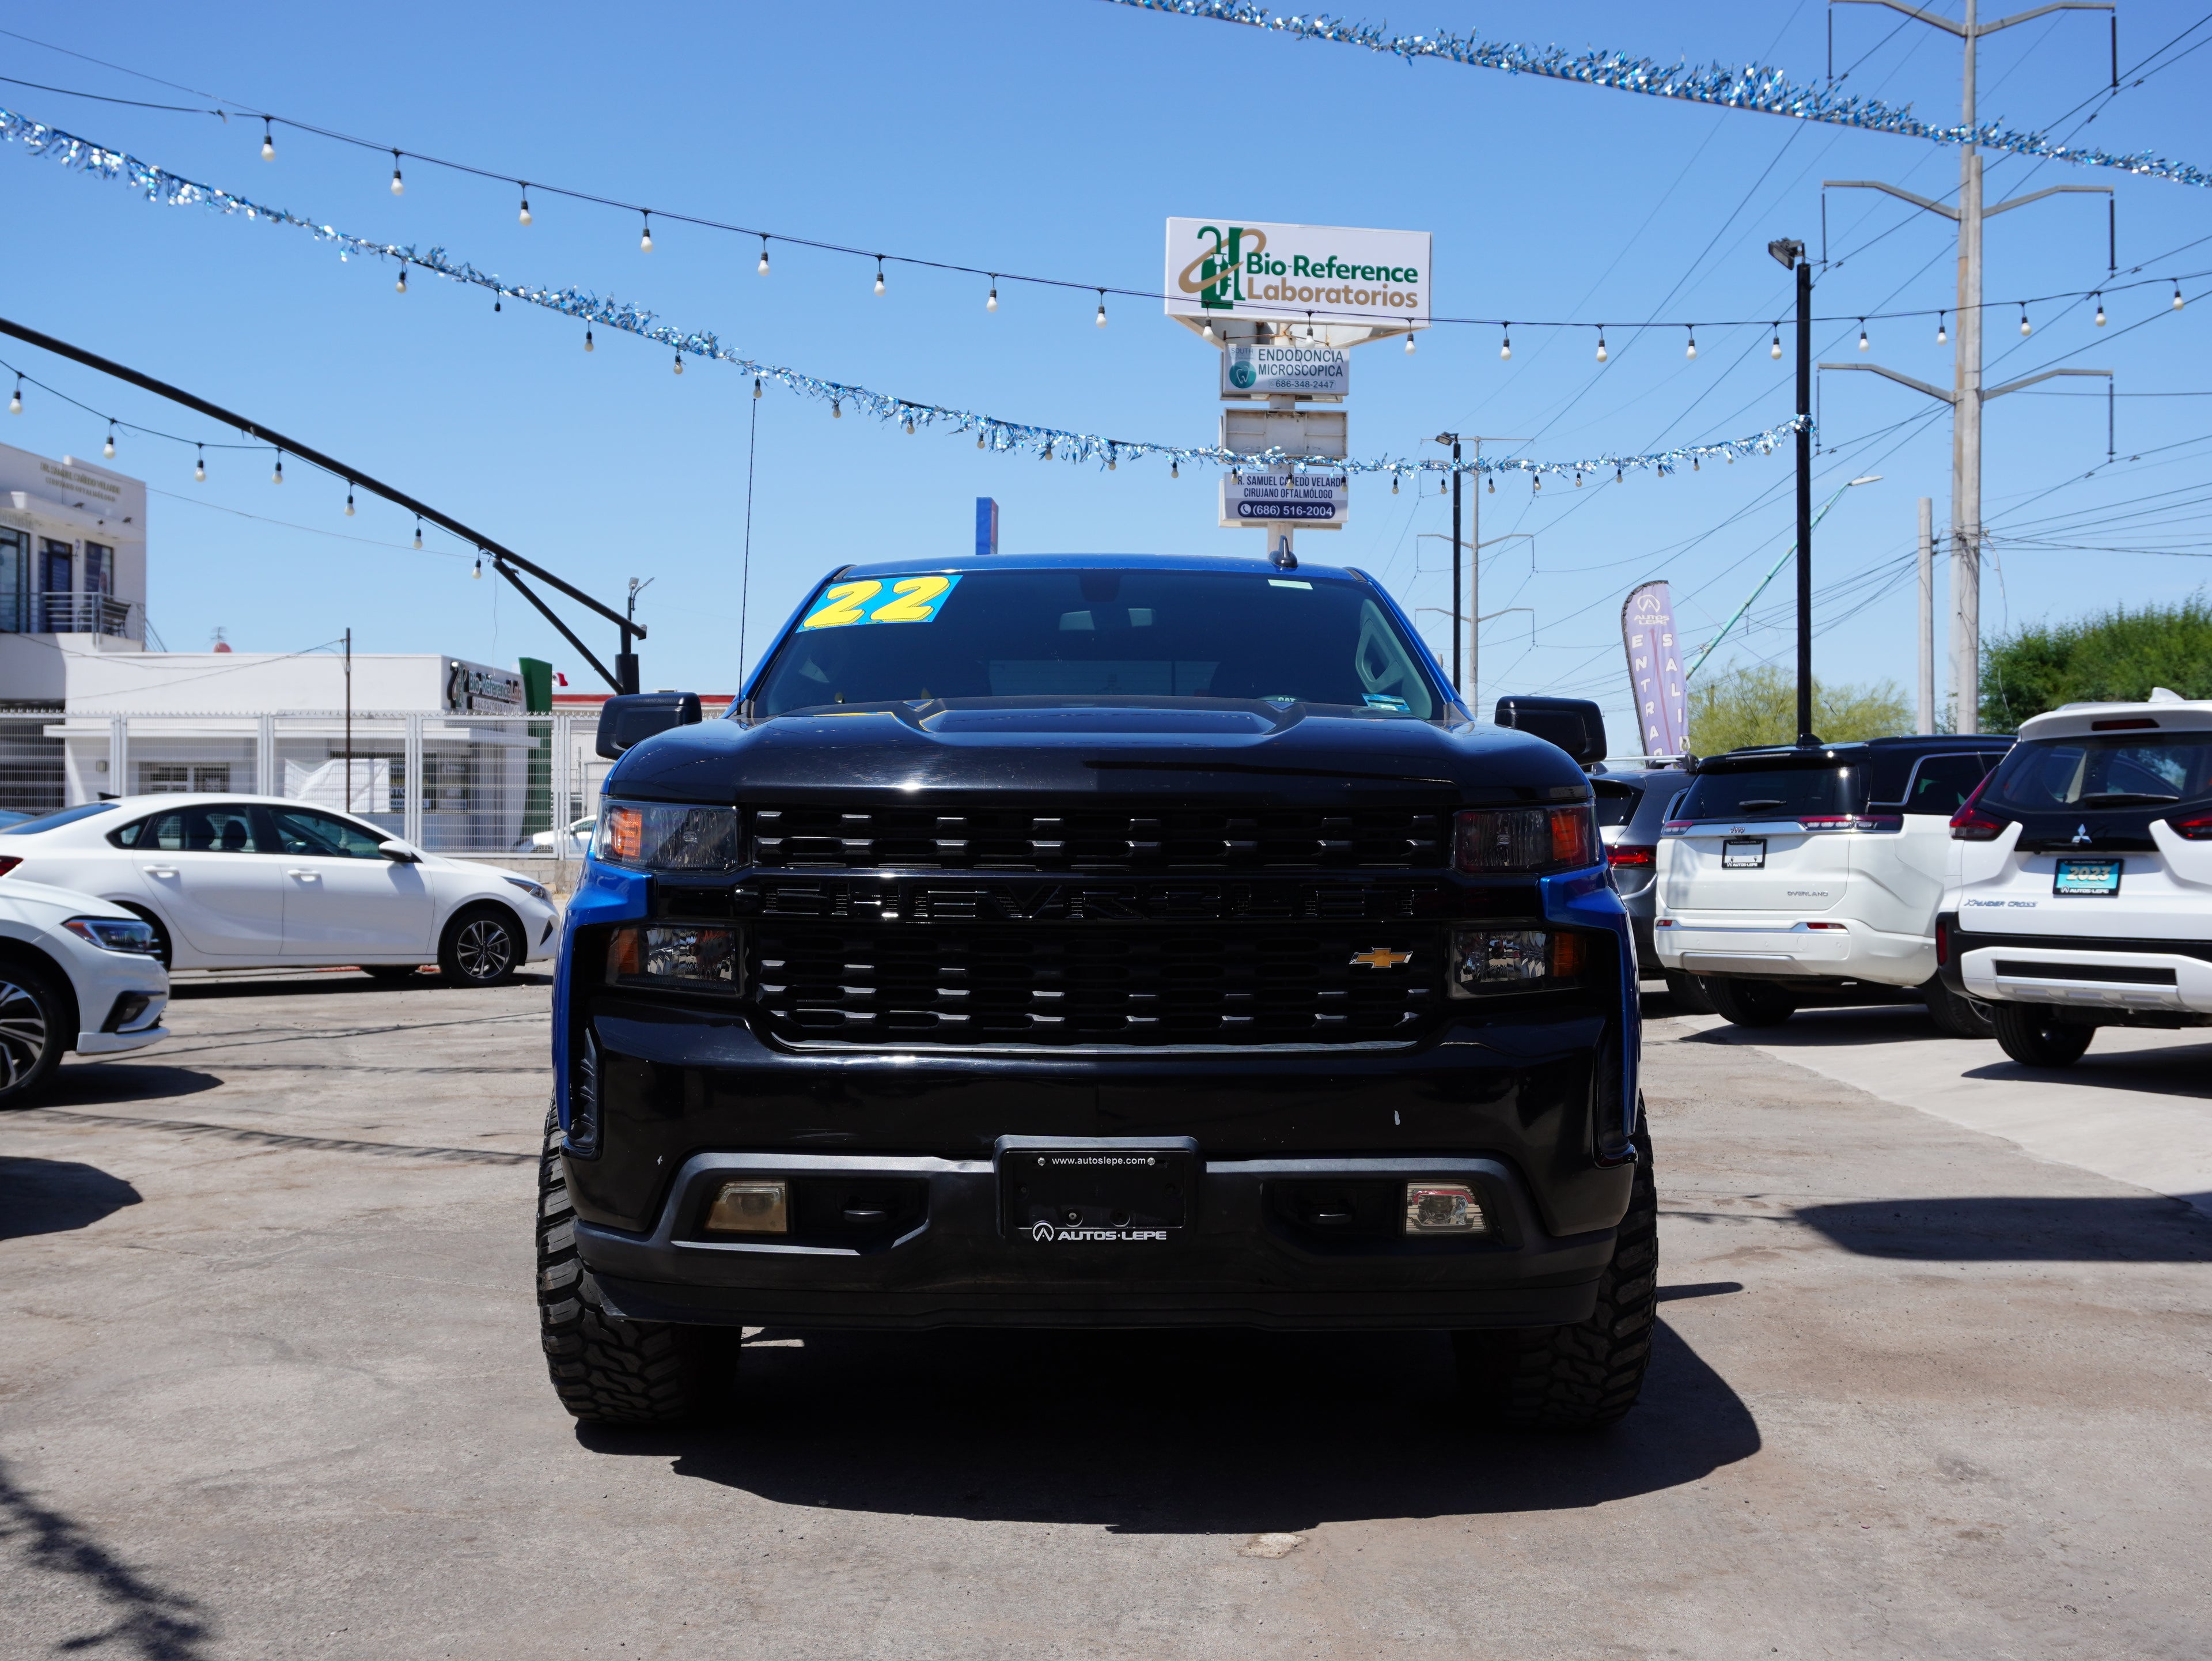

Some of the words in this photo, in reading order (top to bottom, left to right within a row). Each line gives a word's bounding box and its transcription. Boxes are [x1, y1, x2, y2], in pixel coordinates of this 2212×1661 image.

[1247, 251, 1418, 283] Bio-Reference
[1247, 277, 1418, 308] Laboratorios
[1259, 349, 1343, 362] ENDODONCIA
[1259, 364, 1343, 377] MICROSCOPICA
[1275, 380, 1334, 388] 686-348-2447
[1247, 476, 1277, 486] SAMUEL
[1312, 477, 1343, 487] VELARD
[1244, 488, 1278, 498] CIRUJANO
[1281, 487, 1332, 499] OFTALMÓLOGO
[1253, 505, 1280, 516] (686)
[1283, 505, 1333, 516] 516-2004
[803, 576, 951, 629] 22
[1729, 826, 1745, 834] Jeep
[2066, 867, 2112, 881] 2023
[762, 882, 1439, 920] CHEVROLET
[1052, 1157, 1146, 1166] www.autoslepe.com
